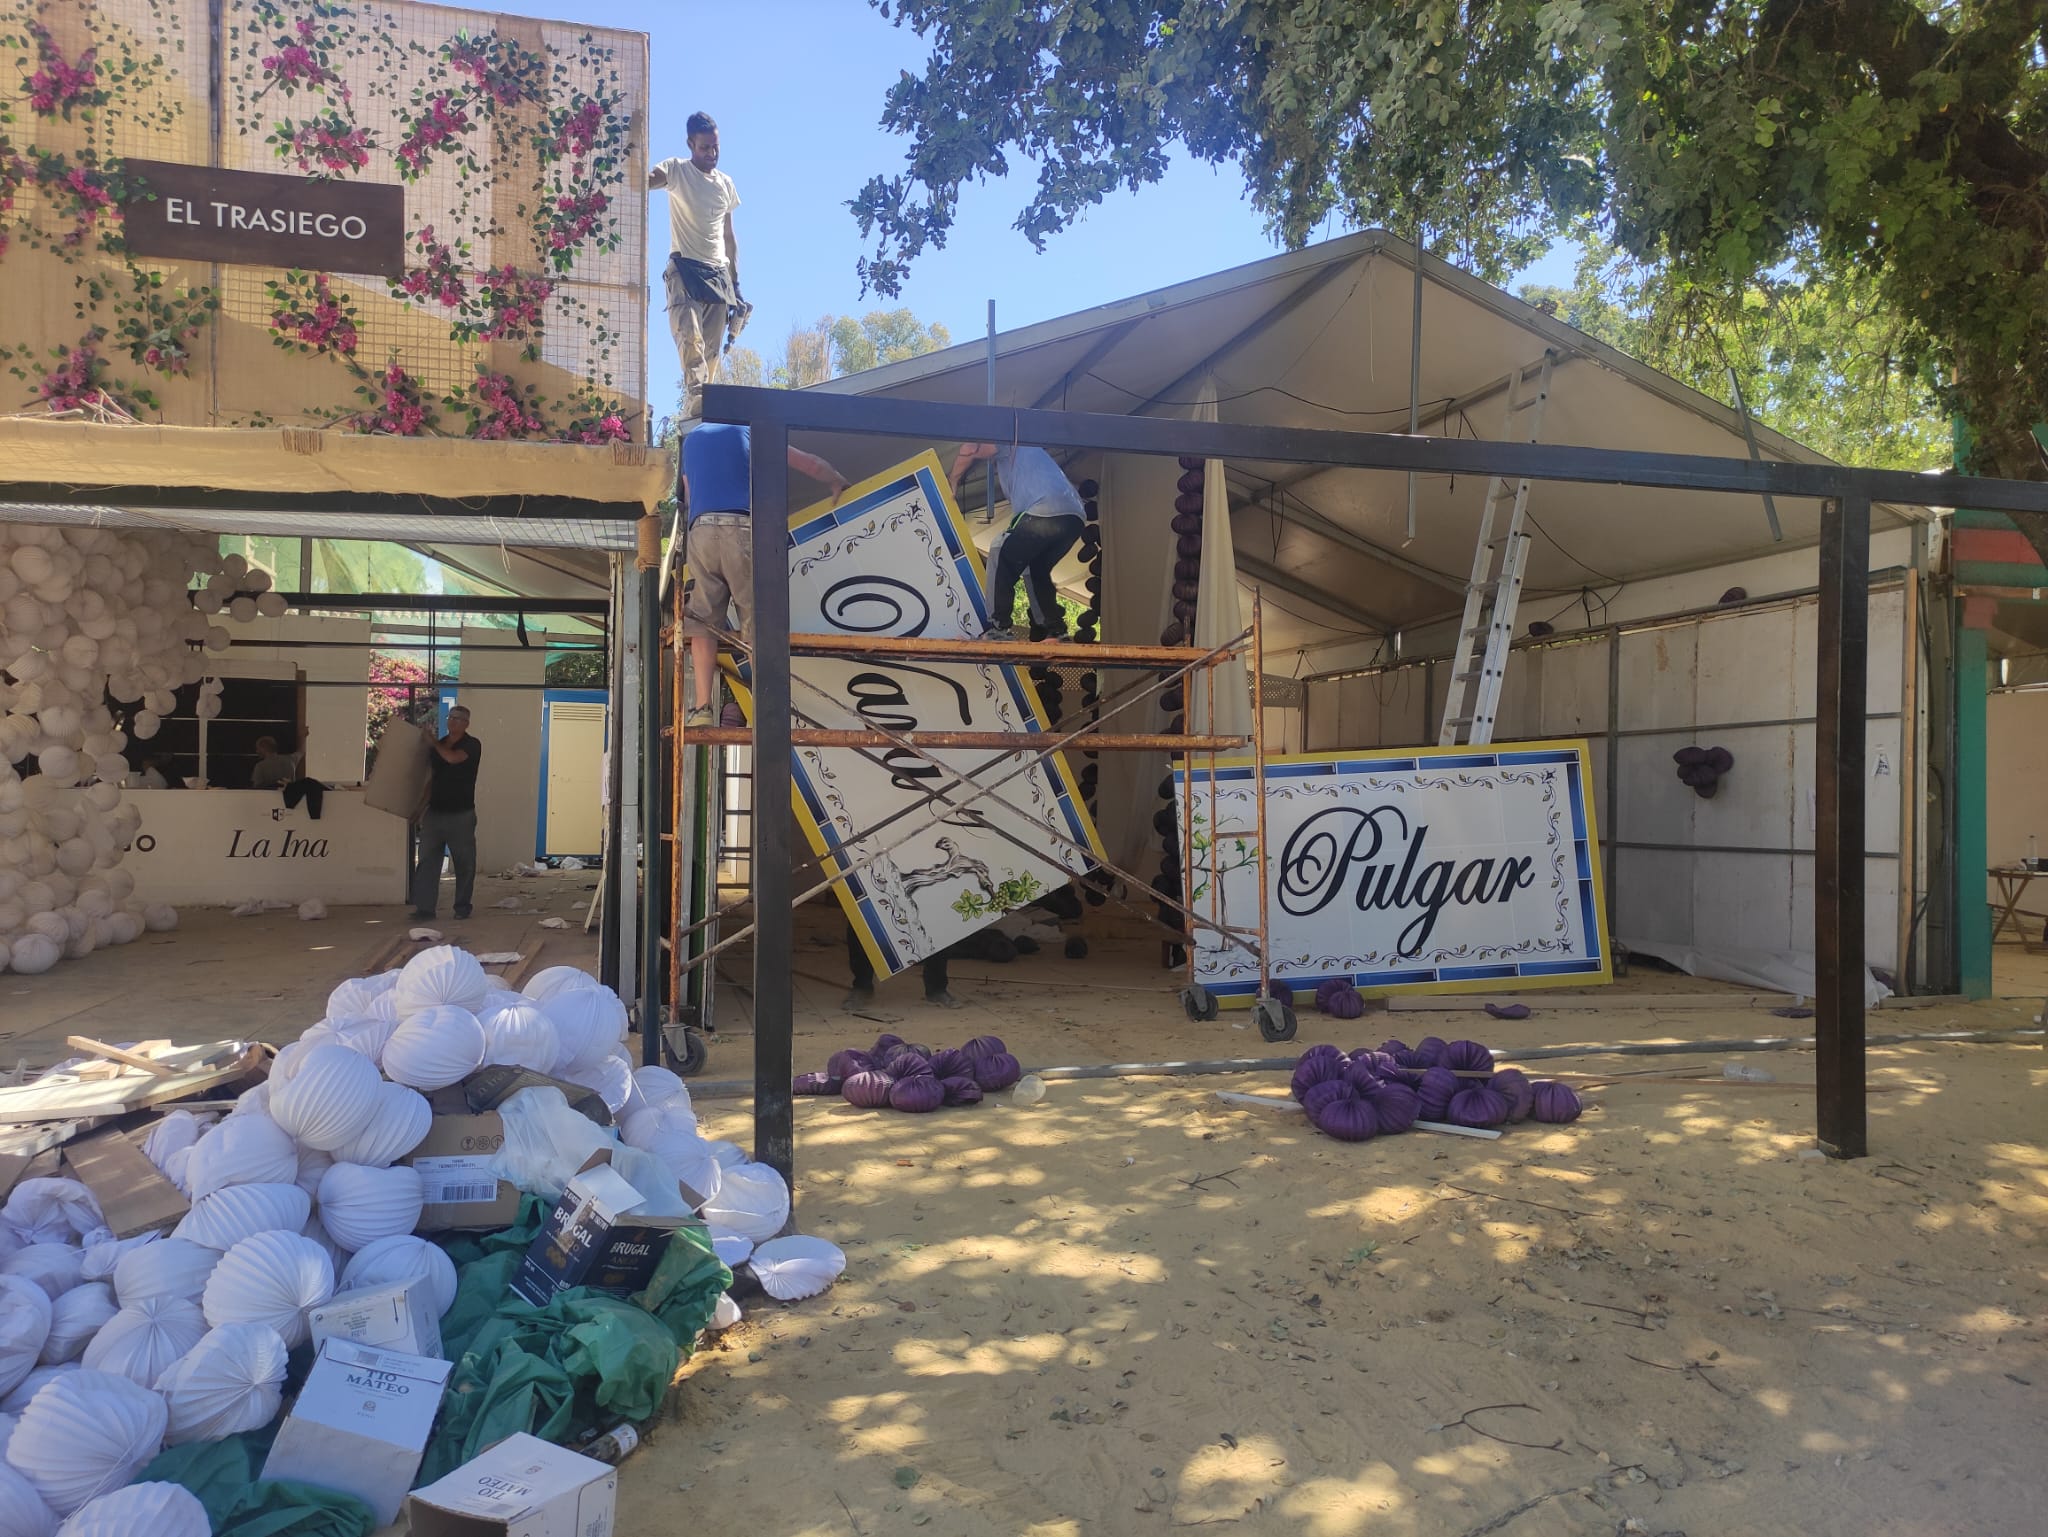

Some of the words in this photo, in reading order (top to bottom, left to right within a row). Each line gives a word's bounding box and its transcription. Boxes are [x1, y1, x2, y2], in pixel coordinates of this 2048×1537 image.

[166, 197, 201, 226] EL
[210, 201, 367, 240] TRASIEGO
[226, 829, 272, 858] La
[277, 829, 329, 858] Ina
[1277, 804, 1536, 958] Pulgar
[345, 1374, 410, 1395] MATEO
[478, 1476, 533, 1496] MATEO
